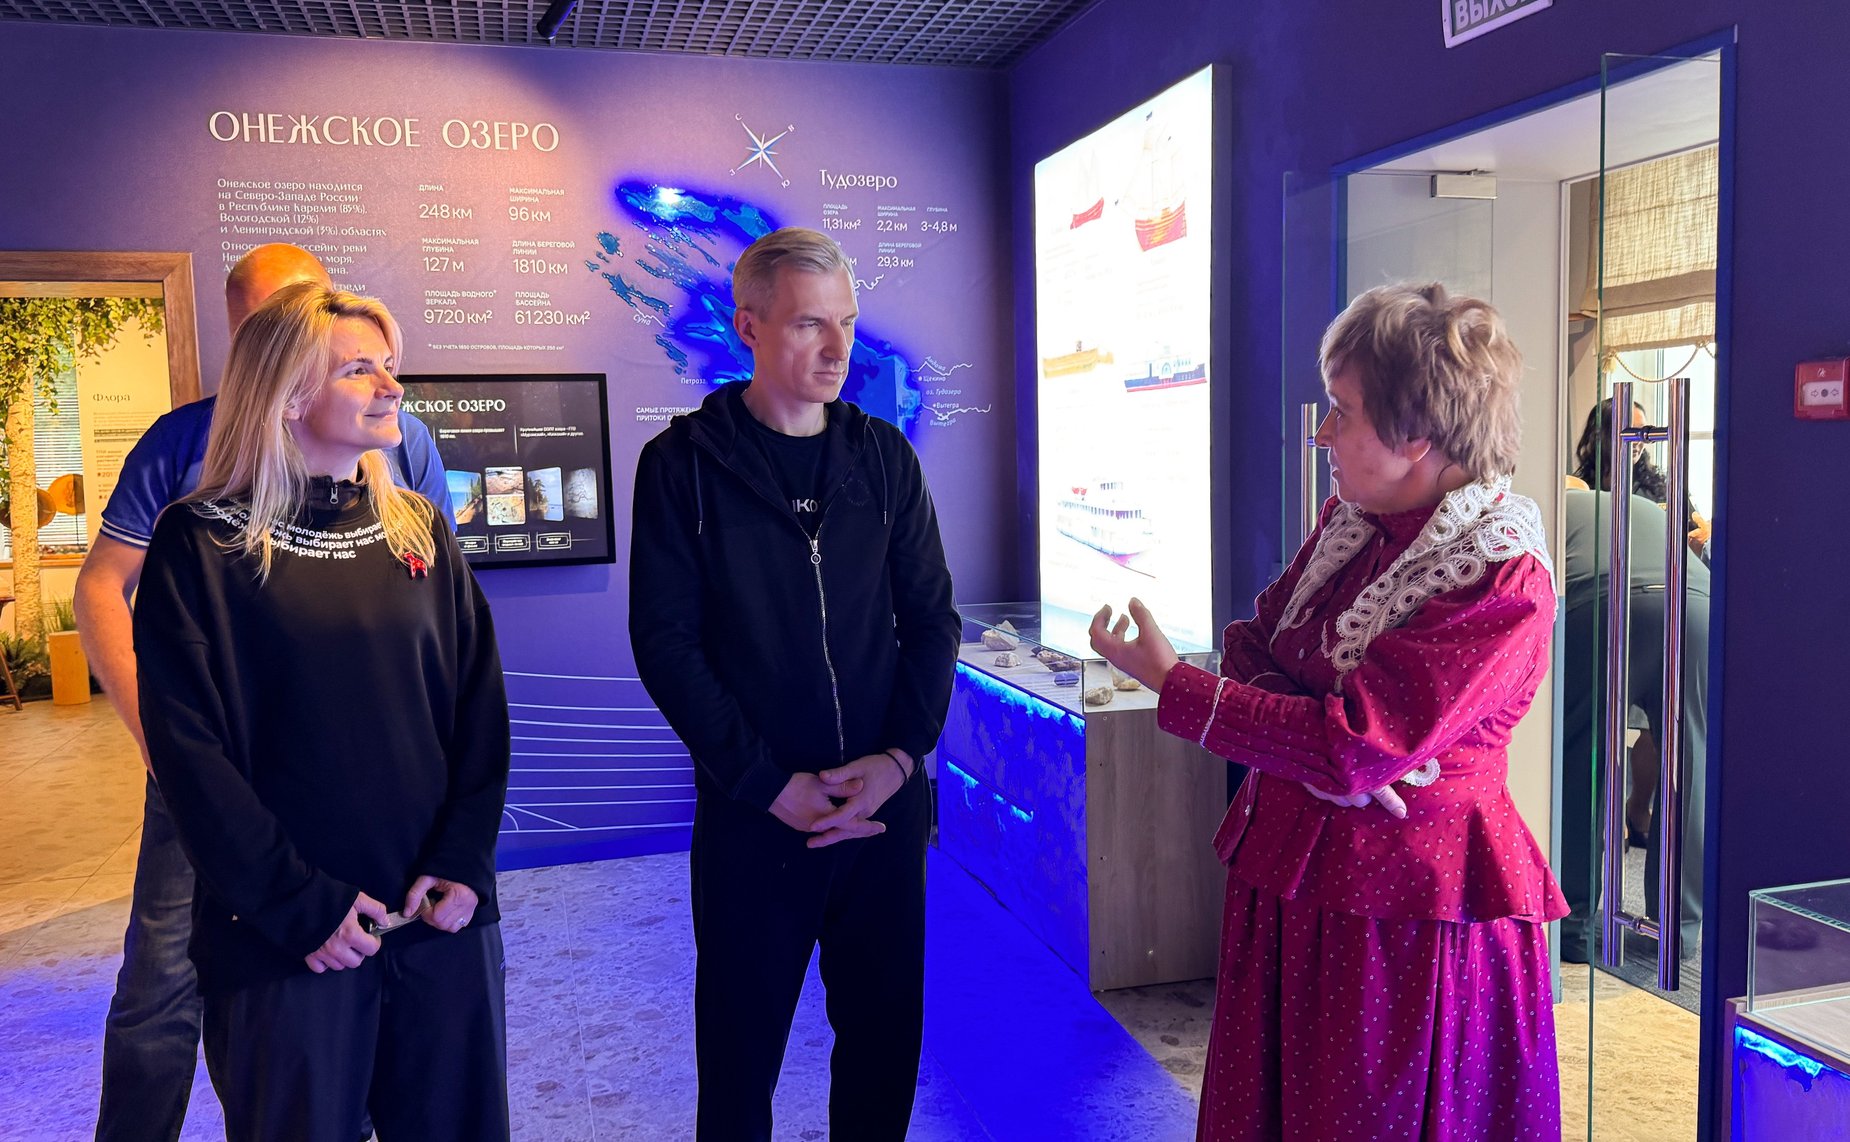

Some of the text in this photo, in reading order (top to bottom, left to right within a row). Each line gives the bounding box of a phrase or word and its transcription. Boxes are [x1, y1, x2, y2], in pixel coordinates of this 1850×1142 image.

[1455, 0, 1519, 30] ВЫХ
[209, 111, 560, 152] ОНЕЖСКОЕ ОЗЕРО
[217, 178, 363, 192] Онежское озеро находится
[819, 169, 898, 192] Тудозеро
[419, 184, 444, 192] ДЛИНА
[509, 187, 565, 196] МАКСИМАЛЬНАЯ
[218, 190, 359, 203] на Северо-Западе России
[509, 196, 540, 204] ШИРИНА
[219, 203, 225, 211] в
[229, 202, 290, 213] Республике
[293, 203, 337, 214] Карелия
[418, 204, 473, 220] 248 км
[508, 206, 551, 222] 96 км
[220, 213, 290, 224] Вологодской
[822, 218, 843, 231] 11,31
[220, 226, 227, 234] и
[232, 225, 314, 236] Ленинградской
[341, 226, 387, 237] областях
[877, 220, 908, 232] 2,2 км
[920, 221, 958, 234] 3-4,8 м
[421, 238, 480, 246] МАКСИМАЛЬНАЯ
[512, 240, 576, 249] ДЛИНА БЕРЕГОВОЙ
[342, 245, 367, 254] реки
[422, 246, 455, 254] ГЛУБИНА
[512, 248, 537, 256] ЛИНИИ
[423, 257, 465, 273] 127 м
[512, 258, 568, 275] 1810 км
[877, 256, 914, 269] 29,3 км
[425, 290, 461, 298] ПЛОЩАДЬ
[515, 291, 550, 299] ПЛОЩАДЬ
[425, 298, 457, 306] ЗЕРКАЛА
[515, 299, 551, 307] БАССЕЙНА
[424, 309, 465, 324] 9720
[515, 310, 564, 325] 61230
[93, 393, 131, 403] Флора
[402, 399, 506, 413] ЖСКОЕ ОЗЕРО
[286, 523, 343, 540] молодёжь
[344, 521, 383, 540] выбирае
[270, 538, 330, 559] ыбирает
[333, 549, 357, 560] нас
[295, 535, 355, 550] выбирает
[355, 536, 375, 547] нас
